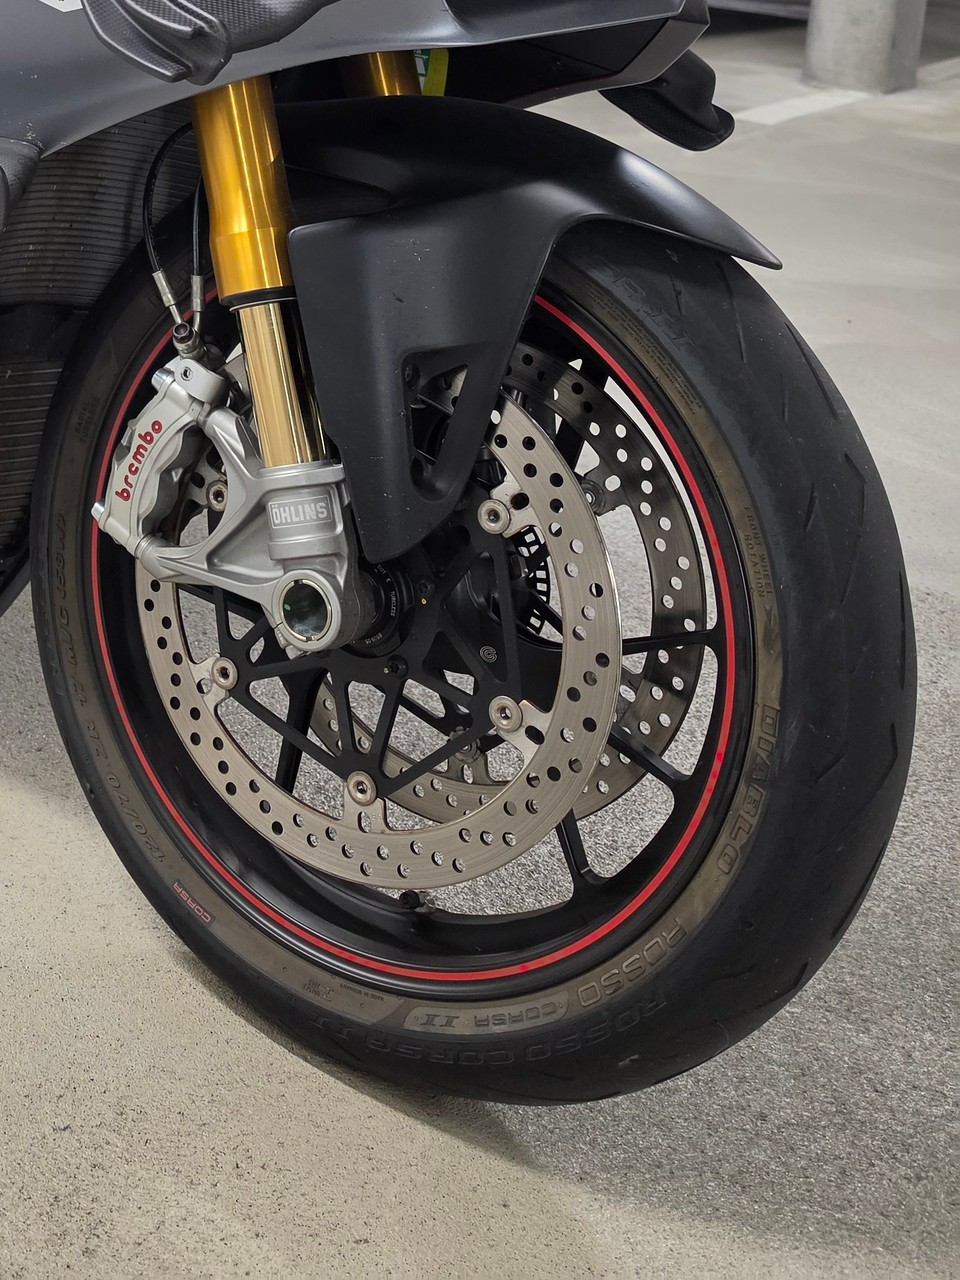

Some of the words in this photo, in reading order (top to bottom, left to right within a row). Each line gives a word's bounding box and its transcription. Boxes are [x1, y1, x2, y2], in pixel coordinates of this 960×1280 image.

[115, 420, 162, 501] brembo
[271, 501, 328, 525] ÖHLINS
[717, 704, 780, 875] DIABLO
[173, 881, 211, 923] CORSA
[578, 918, 687, 1008] ROSSO
[474, 1002, 558, 1028] CORSA
[526, 998, 667, 1061] ROSSO
